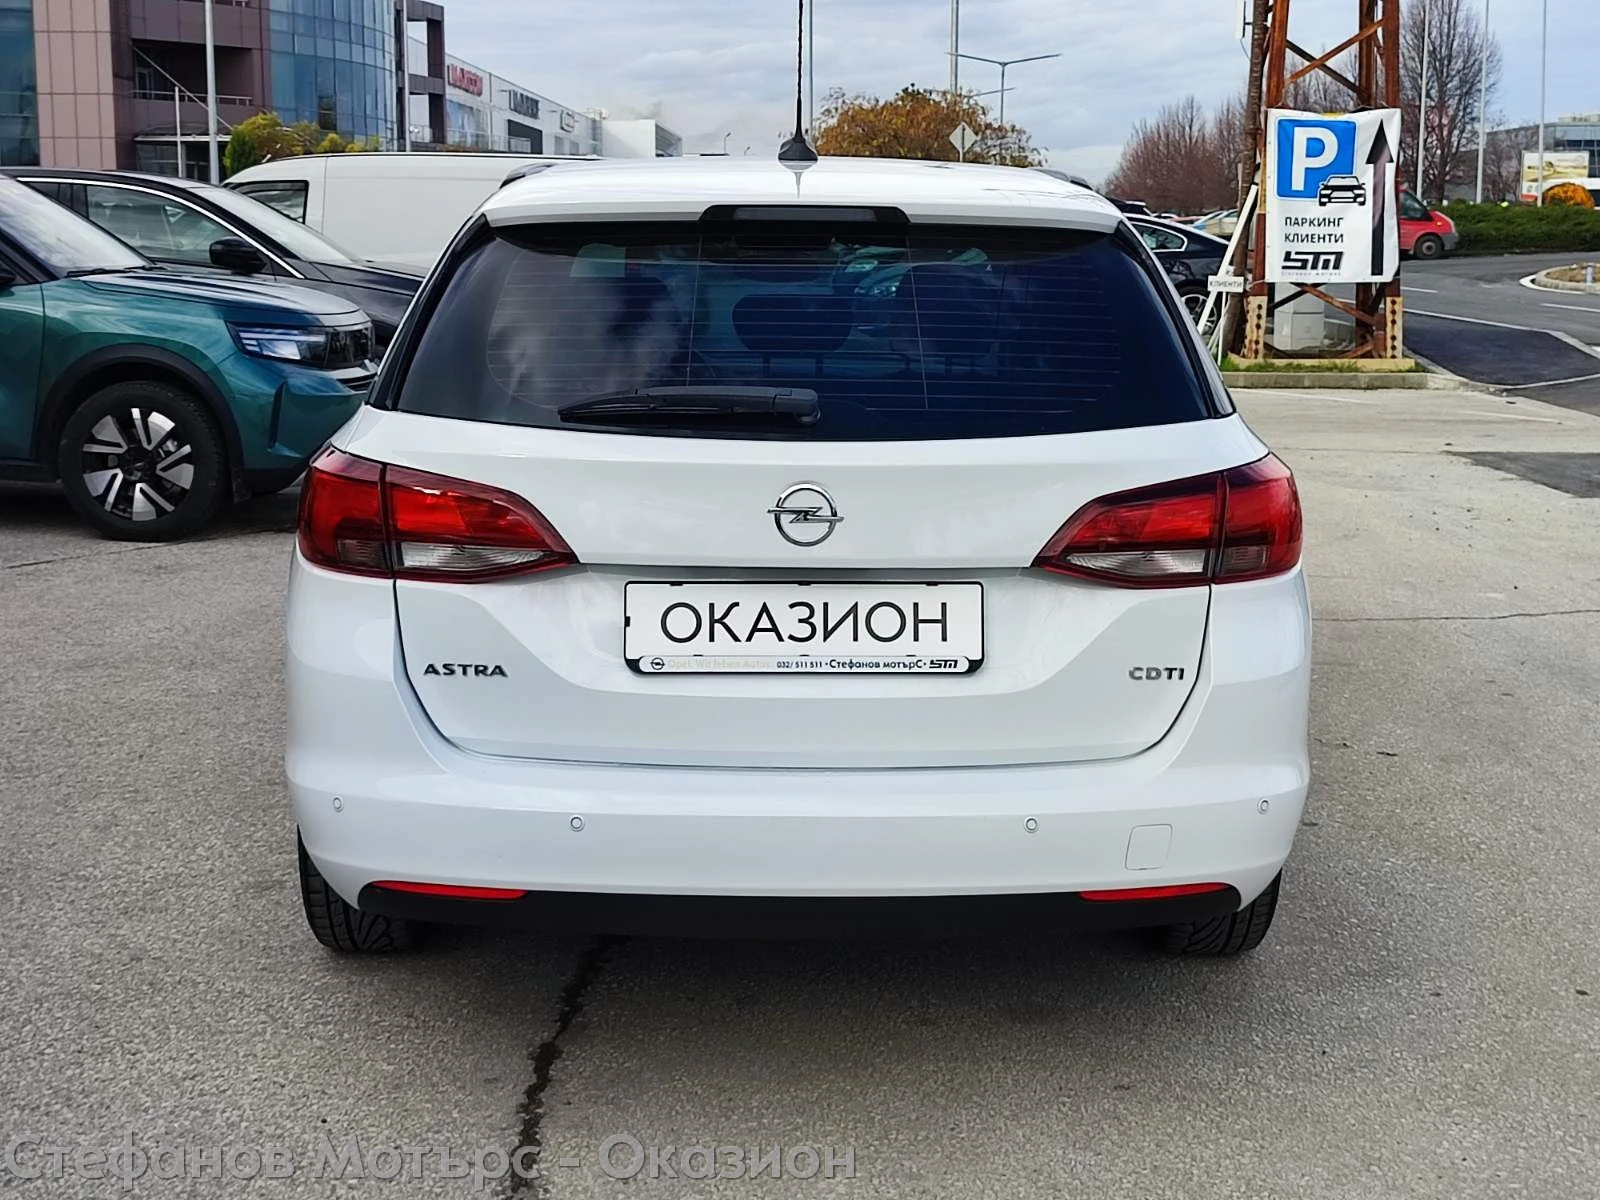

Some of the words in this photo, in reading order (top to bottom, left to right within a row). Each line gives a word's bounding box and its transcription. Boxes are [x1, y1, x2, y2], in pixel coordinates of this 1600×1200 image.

[1291, 126, 1339, 191] P
[1284, 216, 1344, 227] ПАРКИНГ
[1284, 233, 1344, 244] КЛИЕНТИ
[660, 600, 948, 644] ОКАЗИОН
[423, 663, 508, 678] ASTRA
[795, 660, 808, 668] 511
[810, 660, 822, 668] 511
[1128, 666, 1185, 681] CDTI
